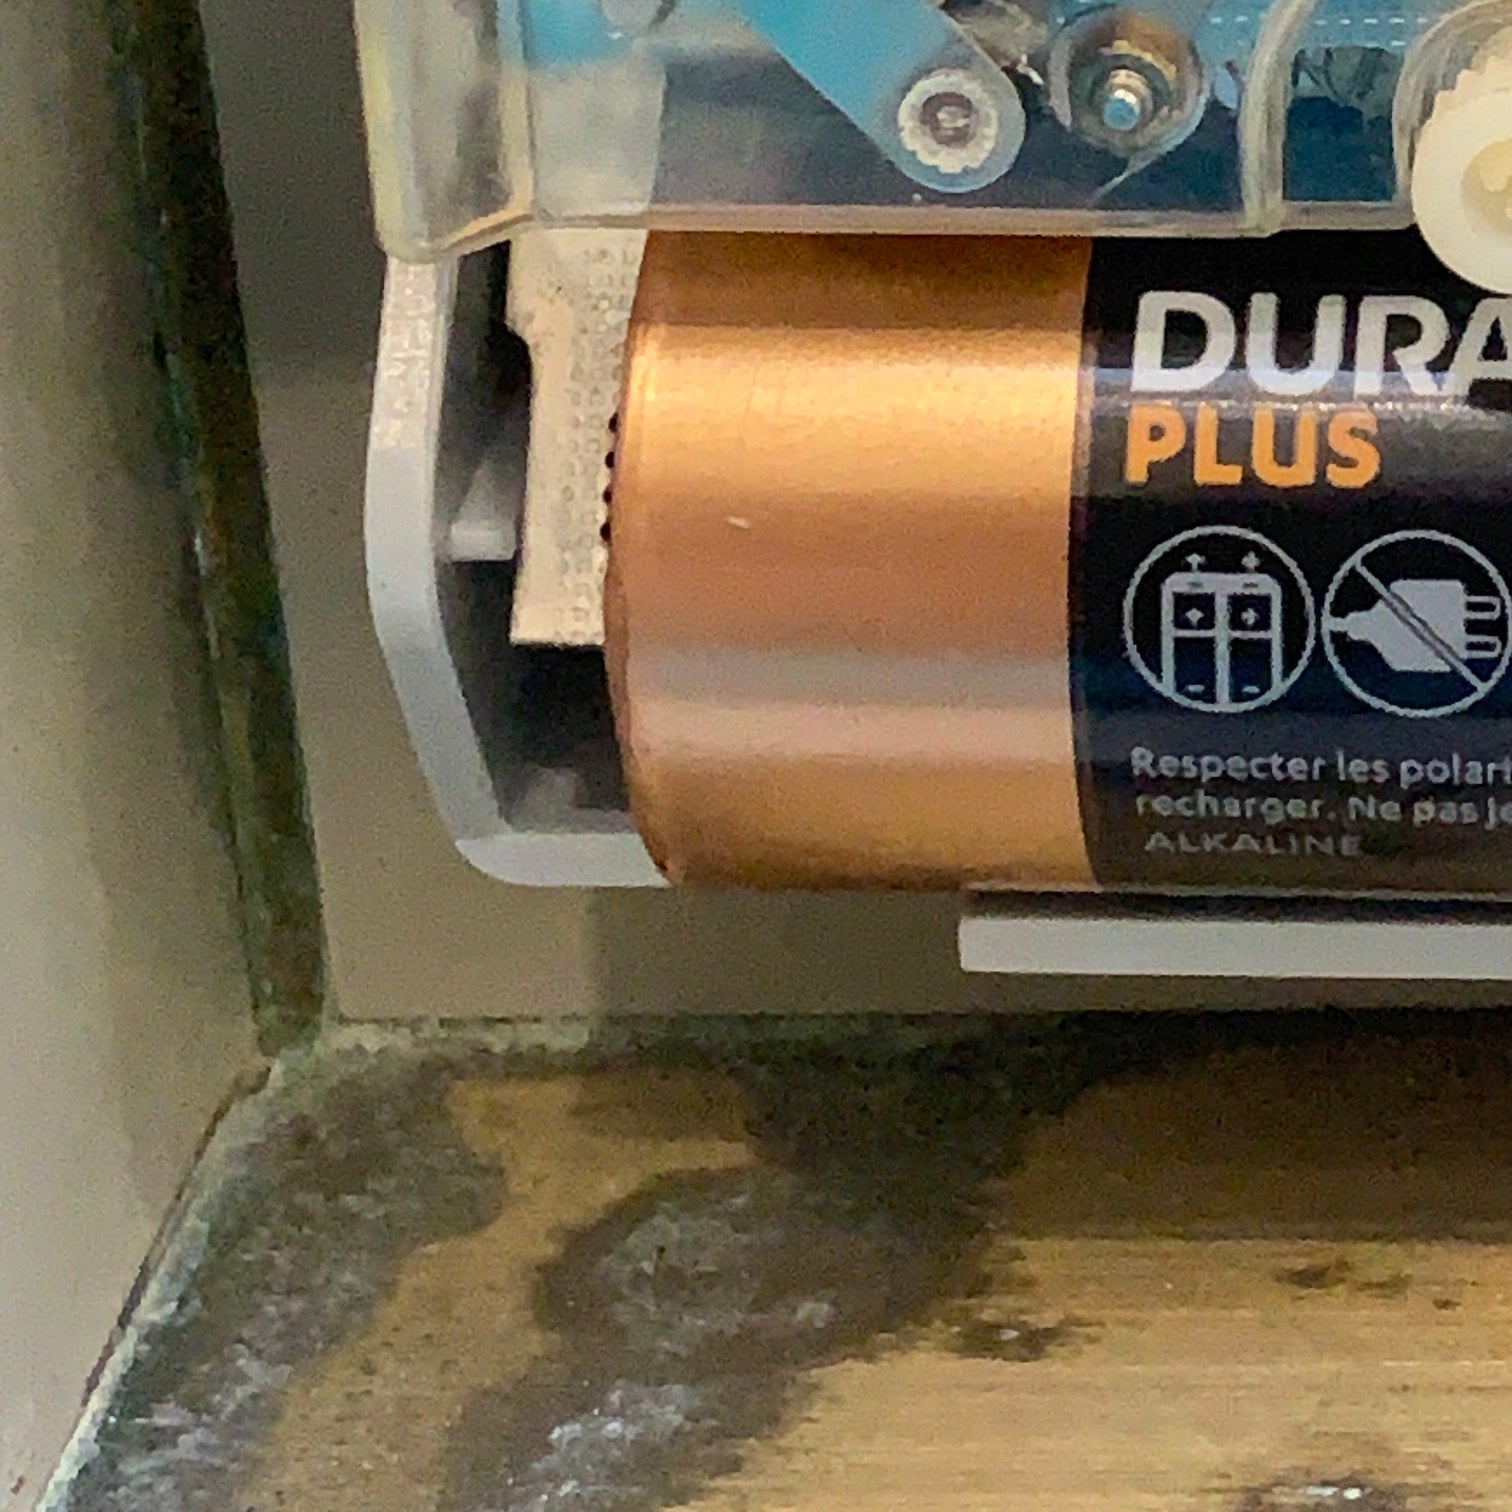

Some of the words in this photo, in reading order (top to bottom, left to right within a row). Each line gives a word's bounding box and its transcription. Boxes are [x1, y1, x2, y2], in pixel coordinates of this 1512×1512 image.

[1124, 404, 1382, 489] PLUS
[1130, 746, 1327, 783] Respecter
[1335, 746, 1392, 783] les
[1136, 789, 1337, 825] recharger.
[1349, 794, 1402, 823] Ne
[1412, 796, 1480, 829] pas
[1144, 832, 1362, 857] ALKALINE
